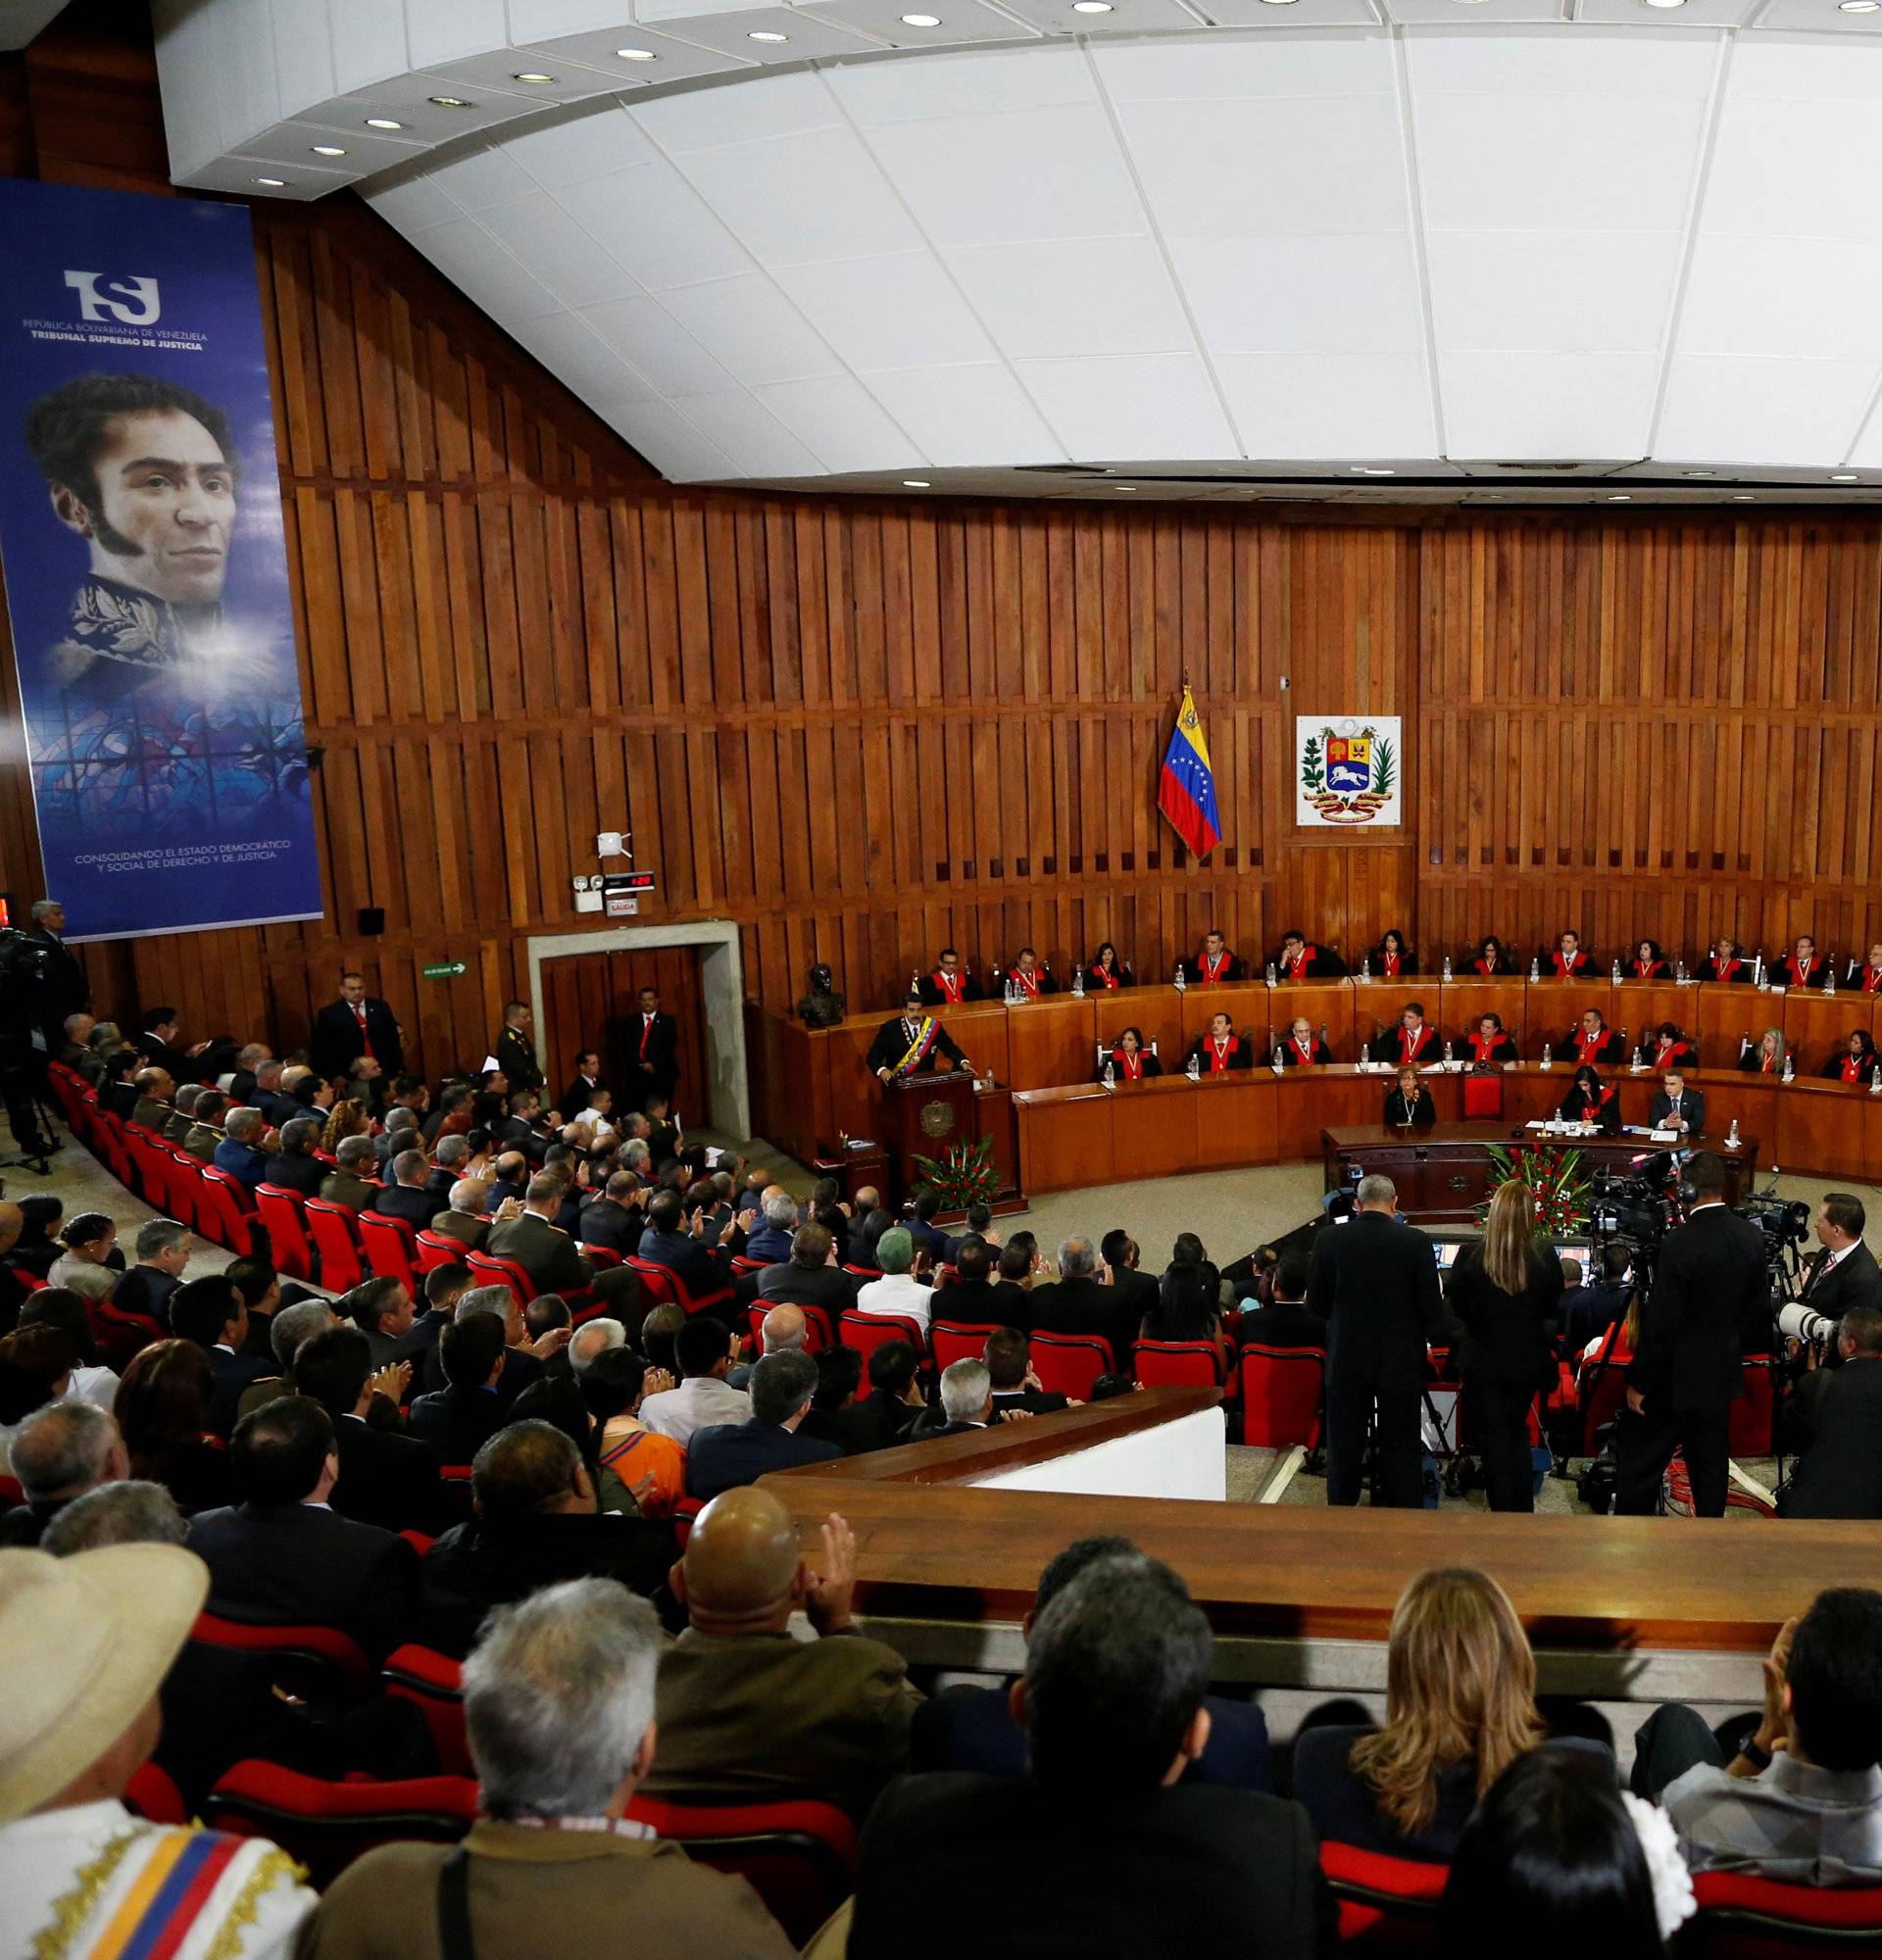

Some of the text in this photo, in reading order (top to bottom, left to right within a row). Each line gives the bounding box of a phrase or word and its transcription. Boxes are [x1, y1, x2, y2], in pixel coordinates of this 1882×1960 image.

[30, 330, 203, 351] TRIBUNAL SUPREMO DE JUSTICIA
[75, 322, 140, 335] BOLIVARIANA
[141, 328, 153, 337] DE
[155, 330, 209, 342] VENEZUELA
[74, 849, 164, 863] CONSOLIDANDO
[178, 846, 217, 856] ESTADO
[97, 863, 104, 872] Y
[107, 861, 145, 872] SOCIAL
[147, 859, 160, 869] DE
[163, 856, 211, 867] DERECHO
[222, 854, 235, 862] DE
[237, 851, 276, 861] JUSTICIA
